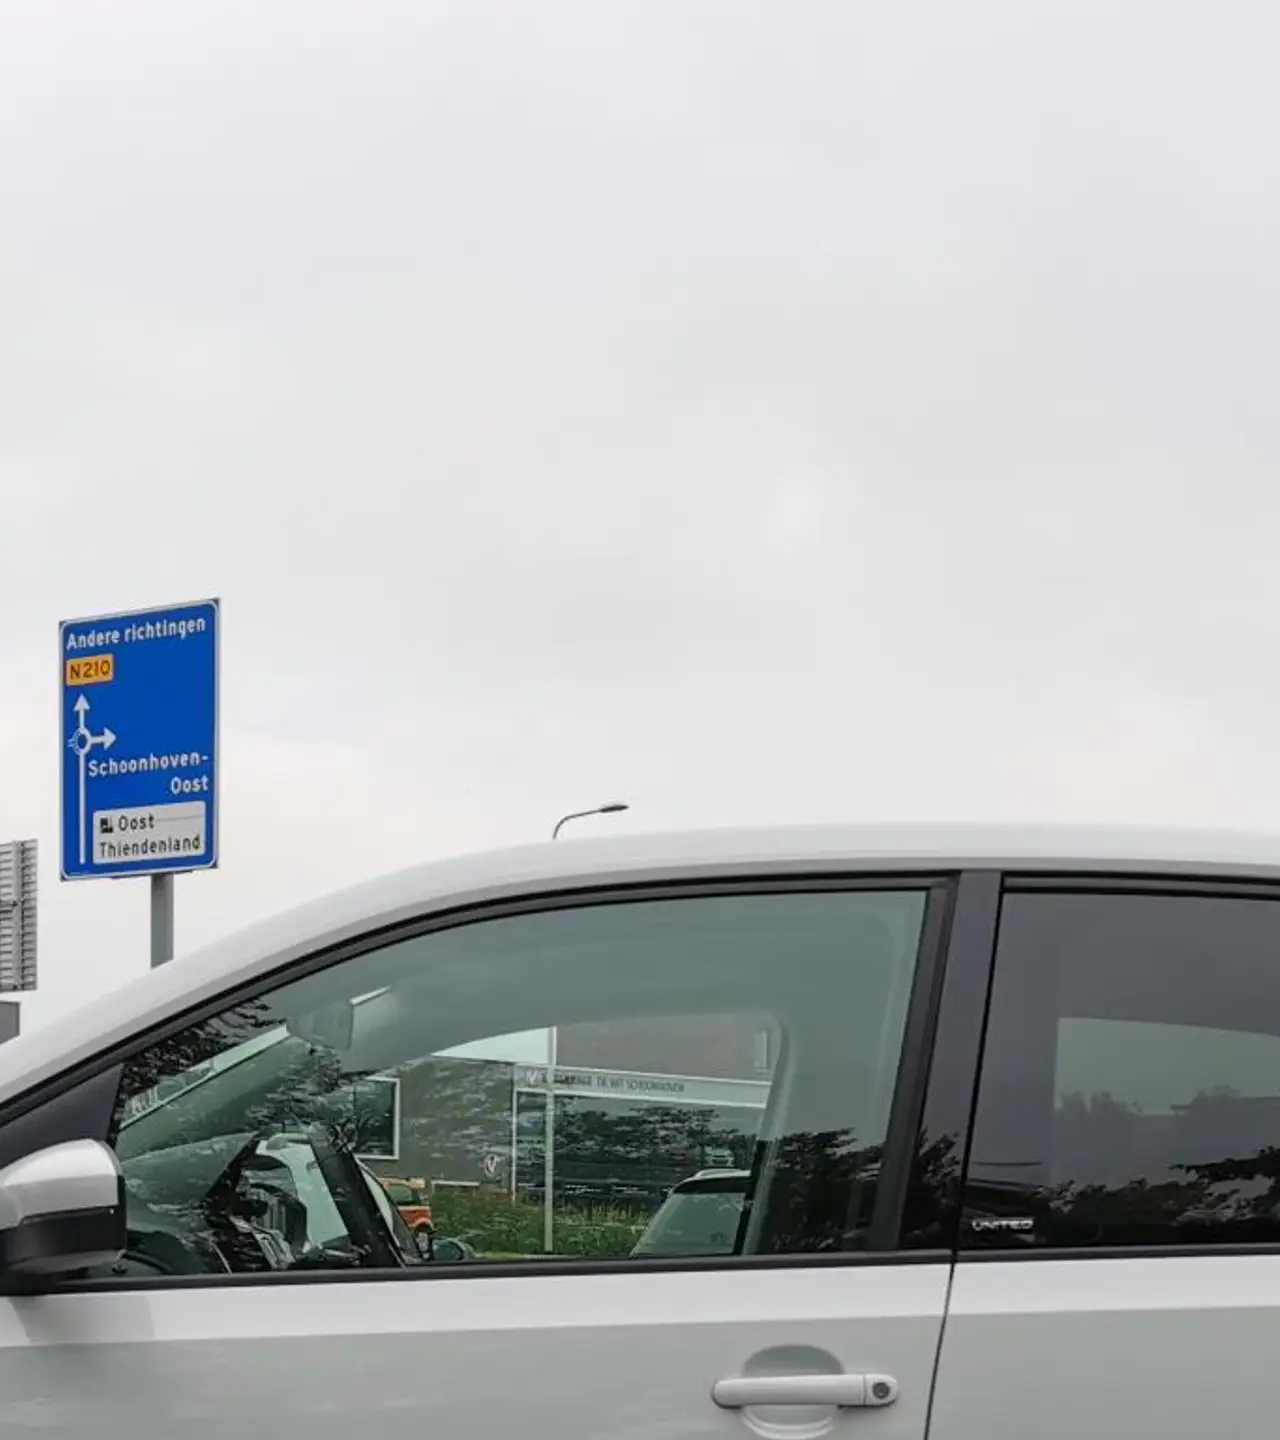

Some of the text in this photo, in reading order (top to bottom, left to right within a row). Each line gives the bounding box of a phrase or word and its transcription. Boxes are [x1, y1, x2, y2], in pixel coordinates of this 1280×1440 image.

[66, 616, 206, 651] Andere richtingen
[69, 660, 111, 680] N210
[88, 751, 209, 778] Schoonhoven-
[170, 775, 209, 795] Oost
[118, 815, 156, 832] Oost
[99, 833, 201, 859] Thiendenland
